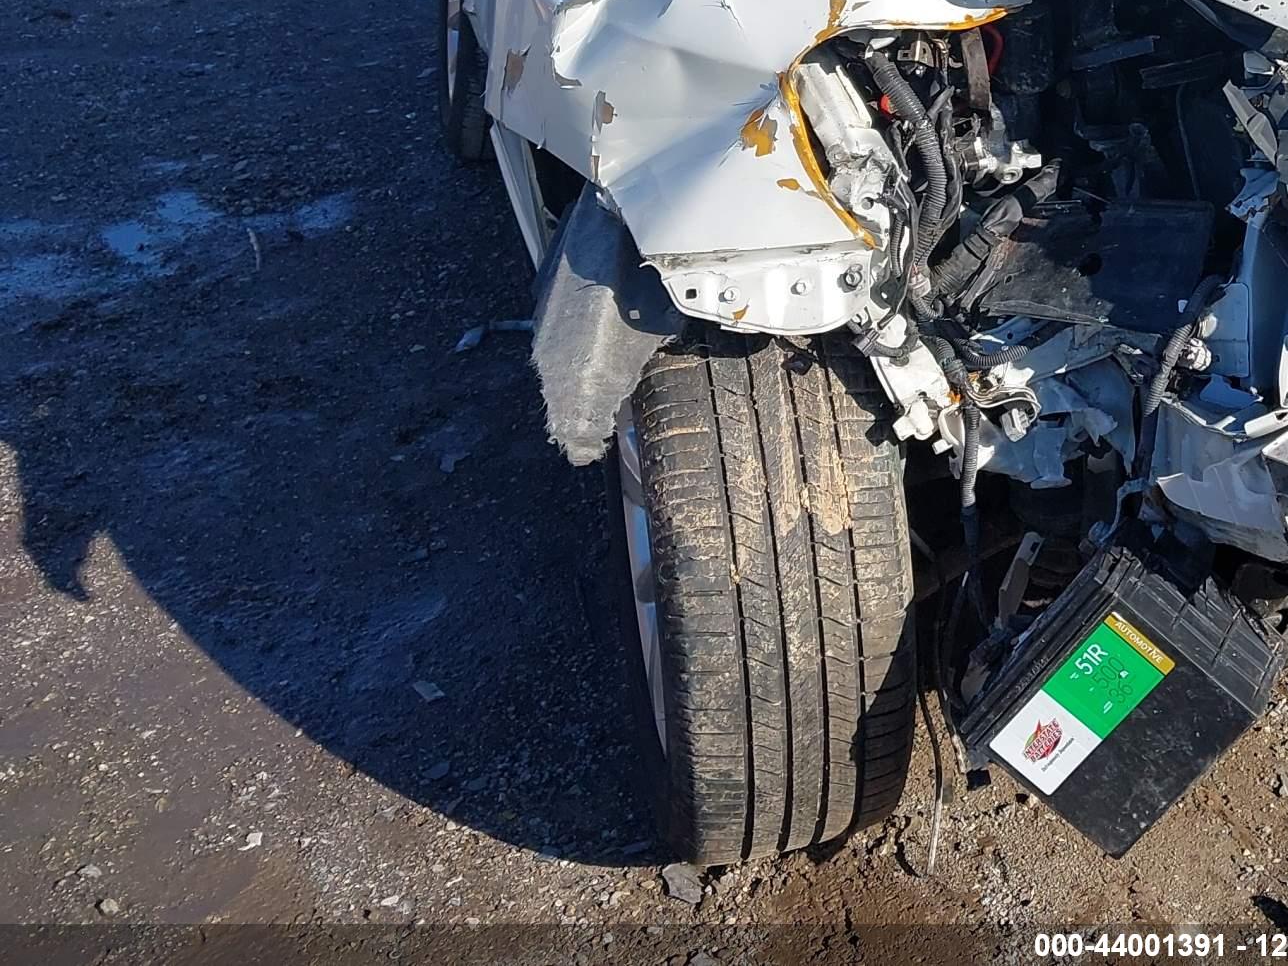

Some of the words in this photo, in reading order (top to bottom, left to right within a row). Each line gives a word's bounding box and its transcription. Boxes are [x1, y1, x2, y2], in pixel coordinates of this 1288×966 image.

[1075, 644, 1109, 675] 51R
[1114, 620, 1164, 664] AUTOMOTIVE
[1023, 718, 1060, 760] INTERSTATE
[1030, 728, 1063, 763] BATTERIES
